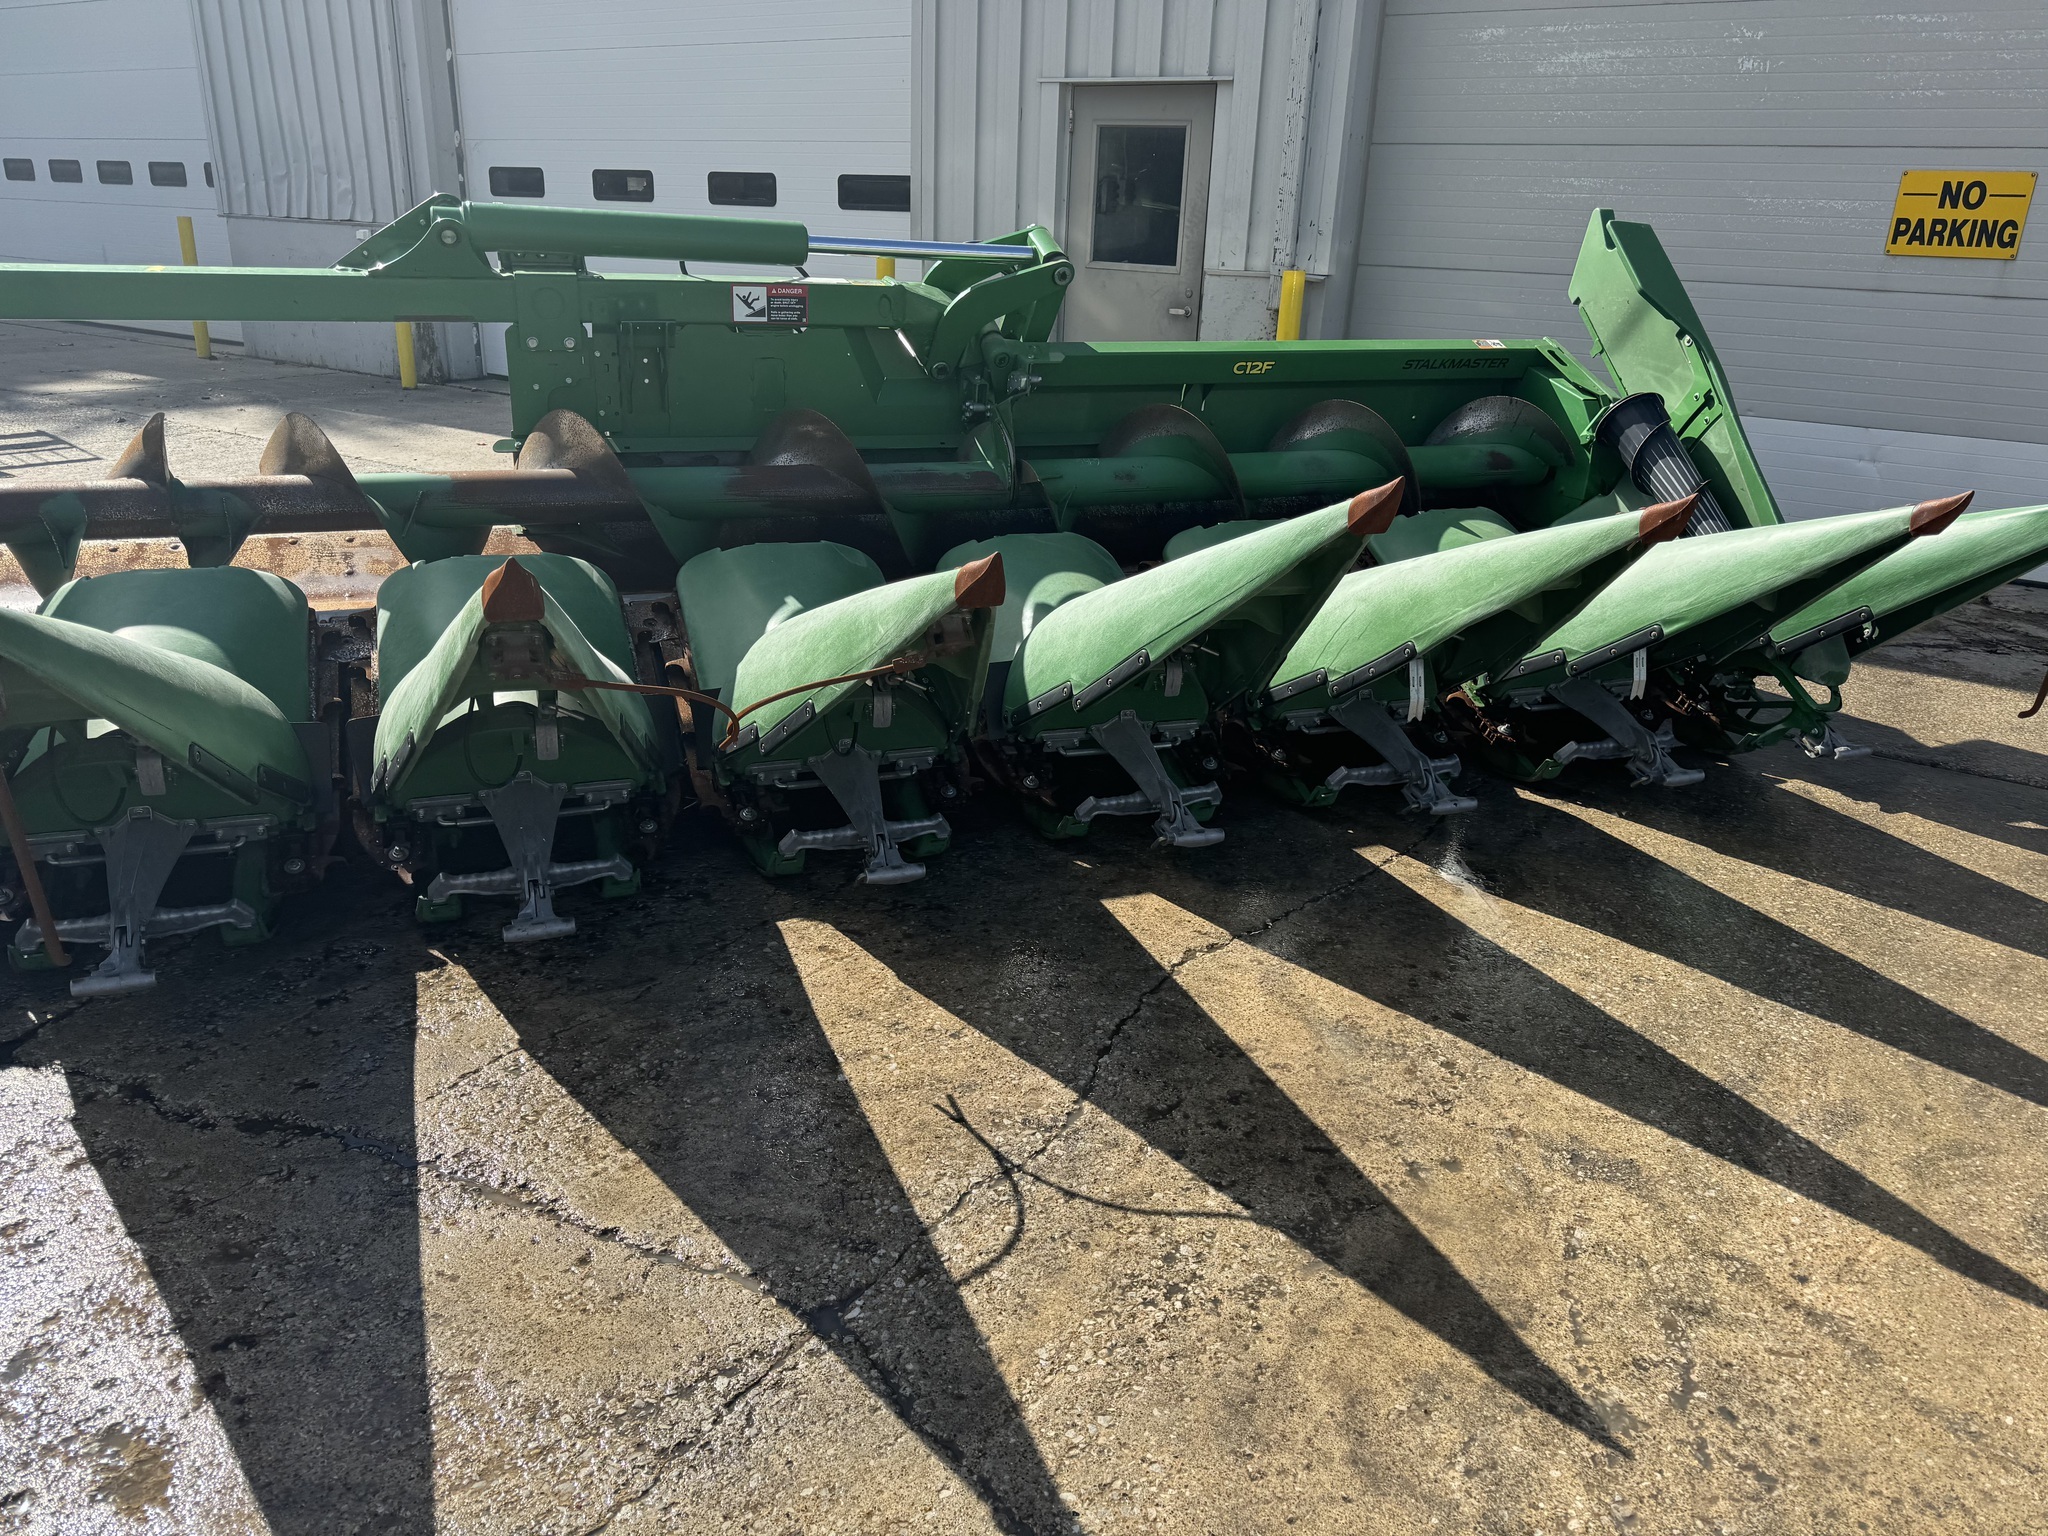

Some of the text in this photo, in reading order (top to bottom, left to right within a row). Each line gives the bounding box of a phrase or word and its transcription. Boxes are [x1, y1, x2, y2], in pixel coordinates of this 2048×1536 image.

[1937, 180, 1987, 210] NO
[1890, 217, 2019, 249] PARKING
[1233, 361, 1276, 375] C12F
[1402, 357, 1510, 370] STALKMASTER
